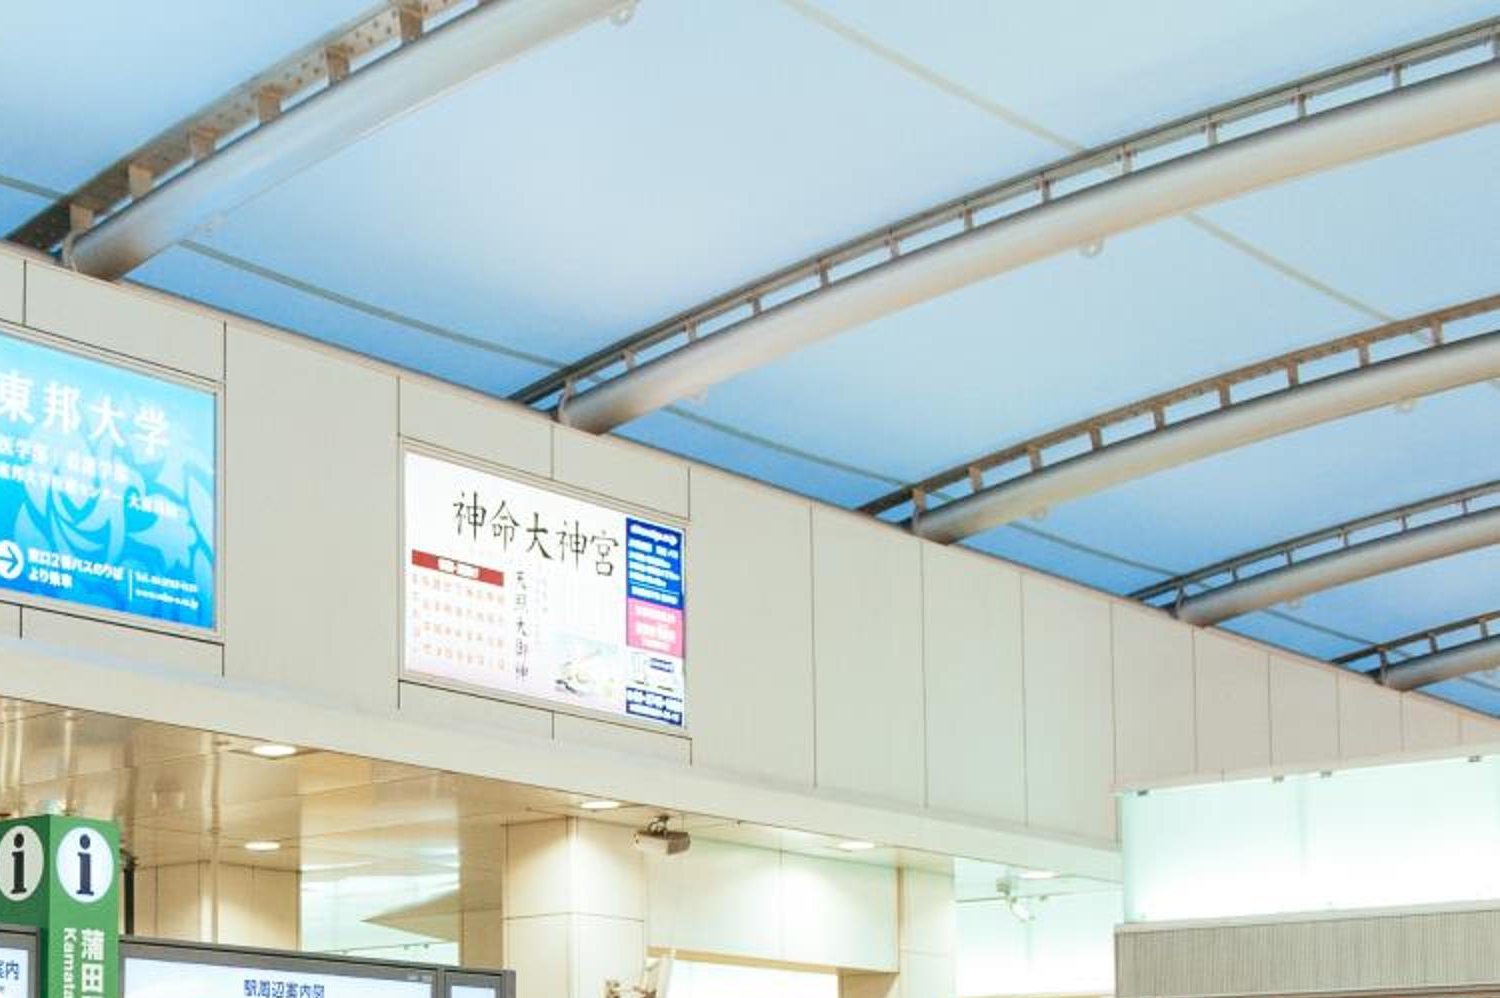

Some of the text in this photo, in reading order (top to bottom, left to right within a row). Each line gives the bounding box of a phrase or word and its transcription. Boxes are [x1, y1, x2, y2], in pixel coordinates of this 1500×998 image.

[452, 490, 619, 577] 神命大神宮
